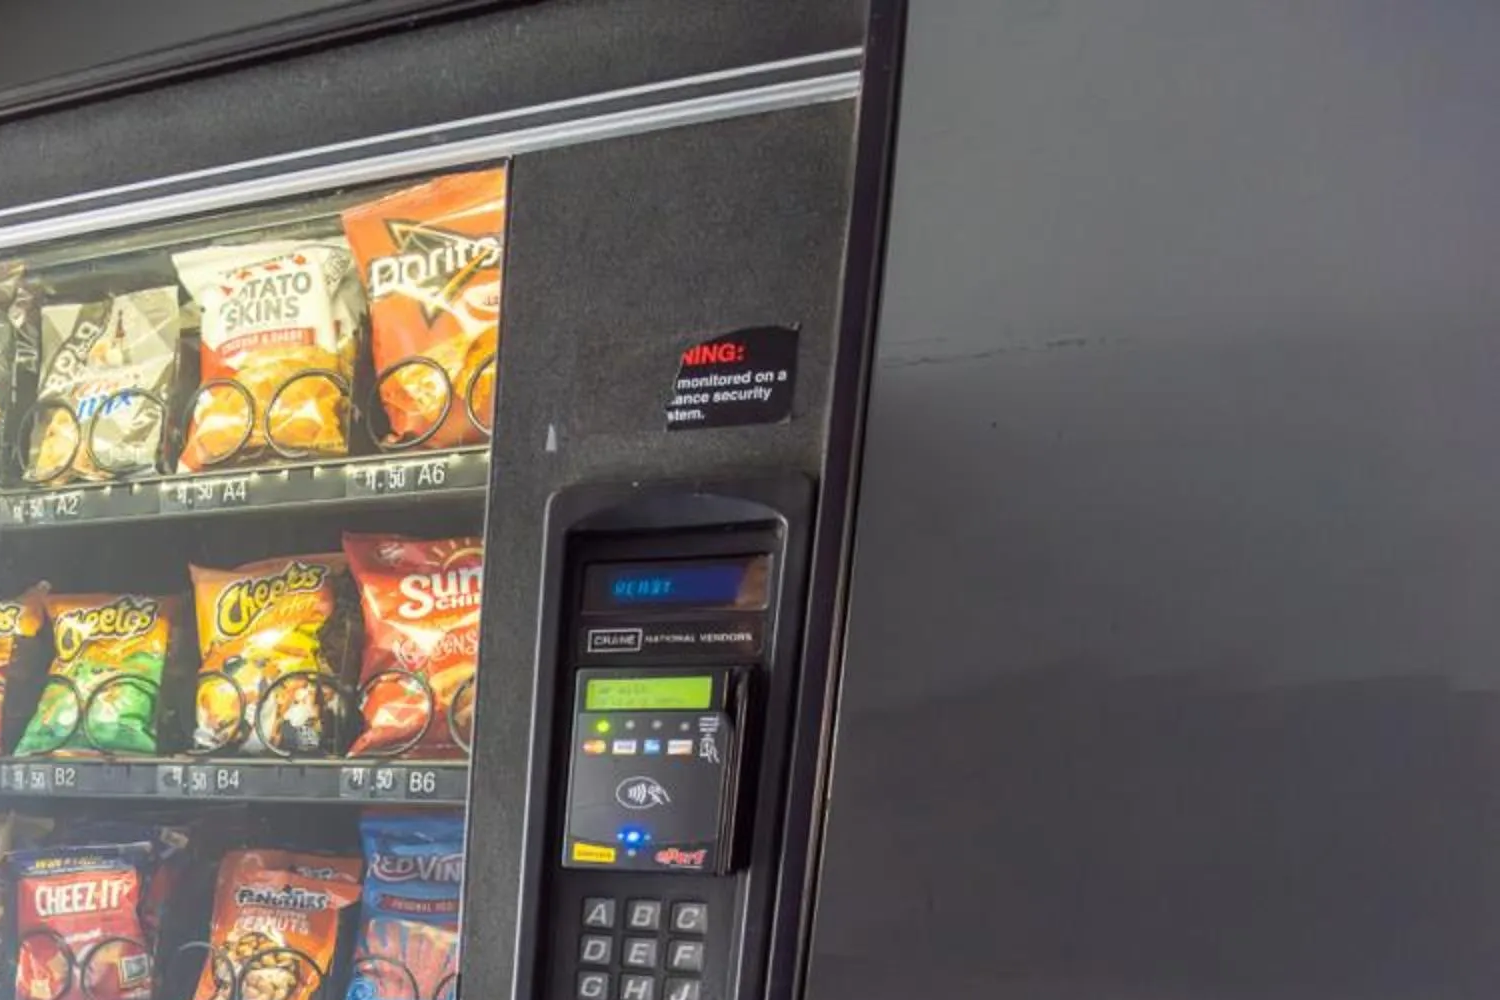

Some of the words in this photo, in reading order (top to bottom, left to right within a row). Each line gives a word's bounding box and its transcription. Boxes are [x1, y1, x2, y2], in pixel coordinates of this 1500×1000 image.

[238, 271, 311, 299] TATO
[222, 296, 299, 331] SKINS
[677, 371, 751, 389] monitored
[755, 371, 774, 383] on
[777, 370, 788, 382] a
[713, 386, 773, 404] security
[417, 463, 445, 485] A6
[222, 480, 247, 501] A4
[56, 496, 78, 515] A2
[218, 563, 326, 638] Cheetos
[593, 634, 637, 646] CRANE
[644, 634, 696, 643] NATIONAL
[700, 632, 753, 643] VENDORS
[54, 767, 77, 787] B2
[216, 769, 240, 790] B4
[408, 771, 436, 793] B6
[367, 853, 414, 880] RED
[35, 879, 124, 917] CHEEZ-IT
[587, 903, 607, 924] A
[631, 905, 654, 926] B
[676, 907, 699, 928] C
[583, 940, 605, 960] D
[628, 943, 649, 963] E
[674, 945, 694, 966] F
[581, 976, 602, 997] G
[623, 980, 648, 1000] H
